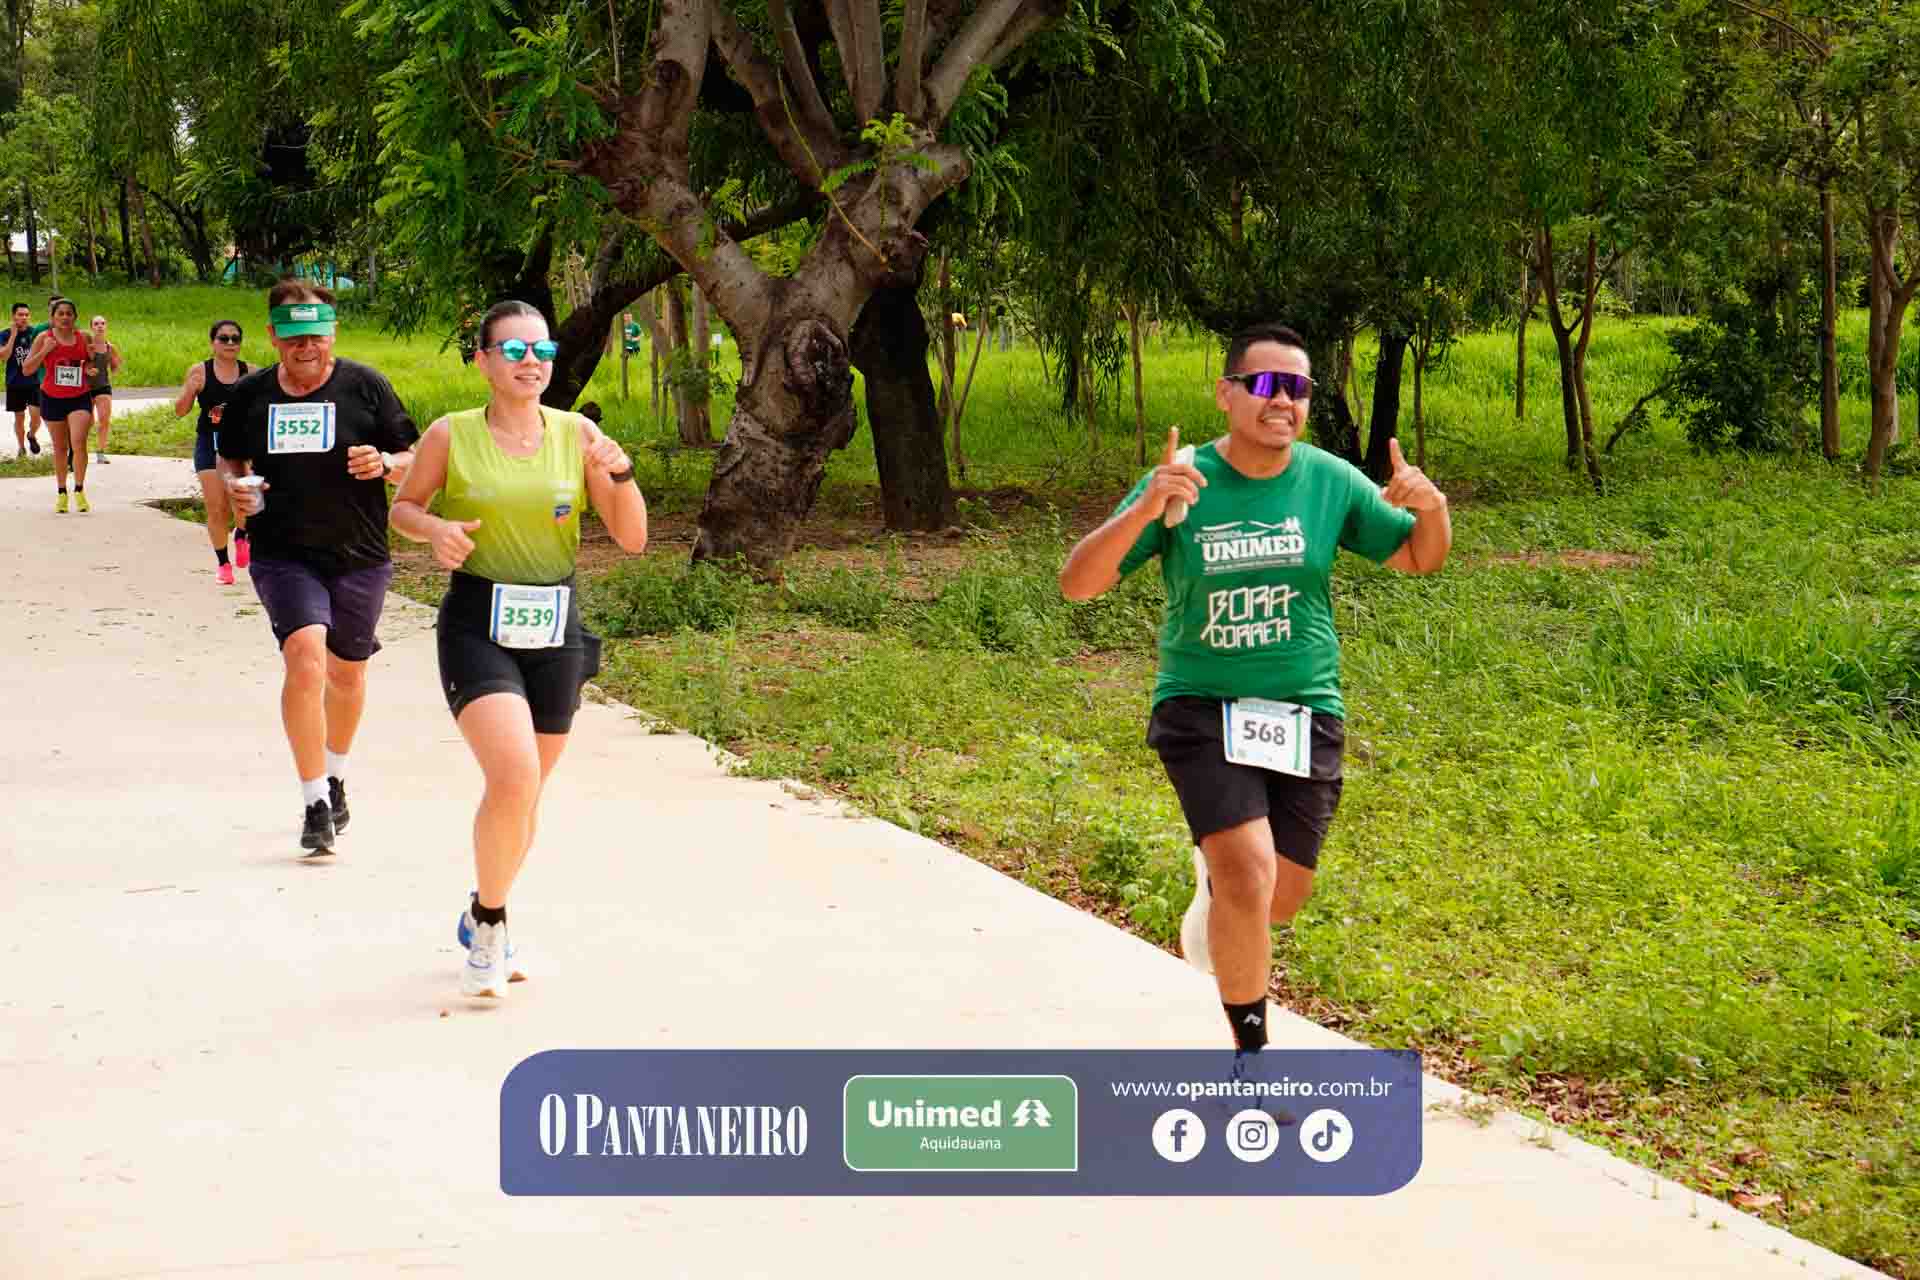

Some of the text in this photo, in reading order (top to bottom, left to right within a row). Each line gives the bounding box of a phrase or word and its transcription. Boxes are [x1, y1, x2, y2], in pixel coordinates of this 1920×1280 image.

[276, 419, 322, 435] 3552
[1202, 535, 1305, 562] UNIMED
[501, 606, 554, 627] 3539
[1201, 584, 1300, 634] BORA
[1209, 618, 1290, 648] CORRER
[1243, 719, 1286, 746] 568
